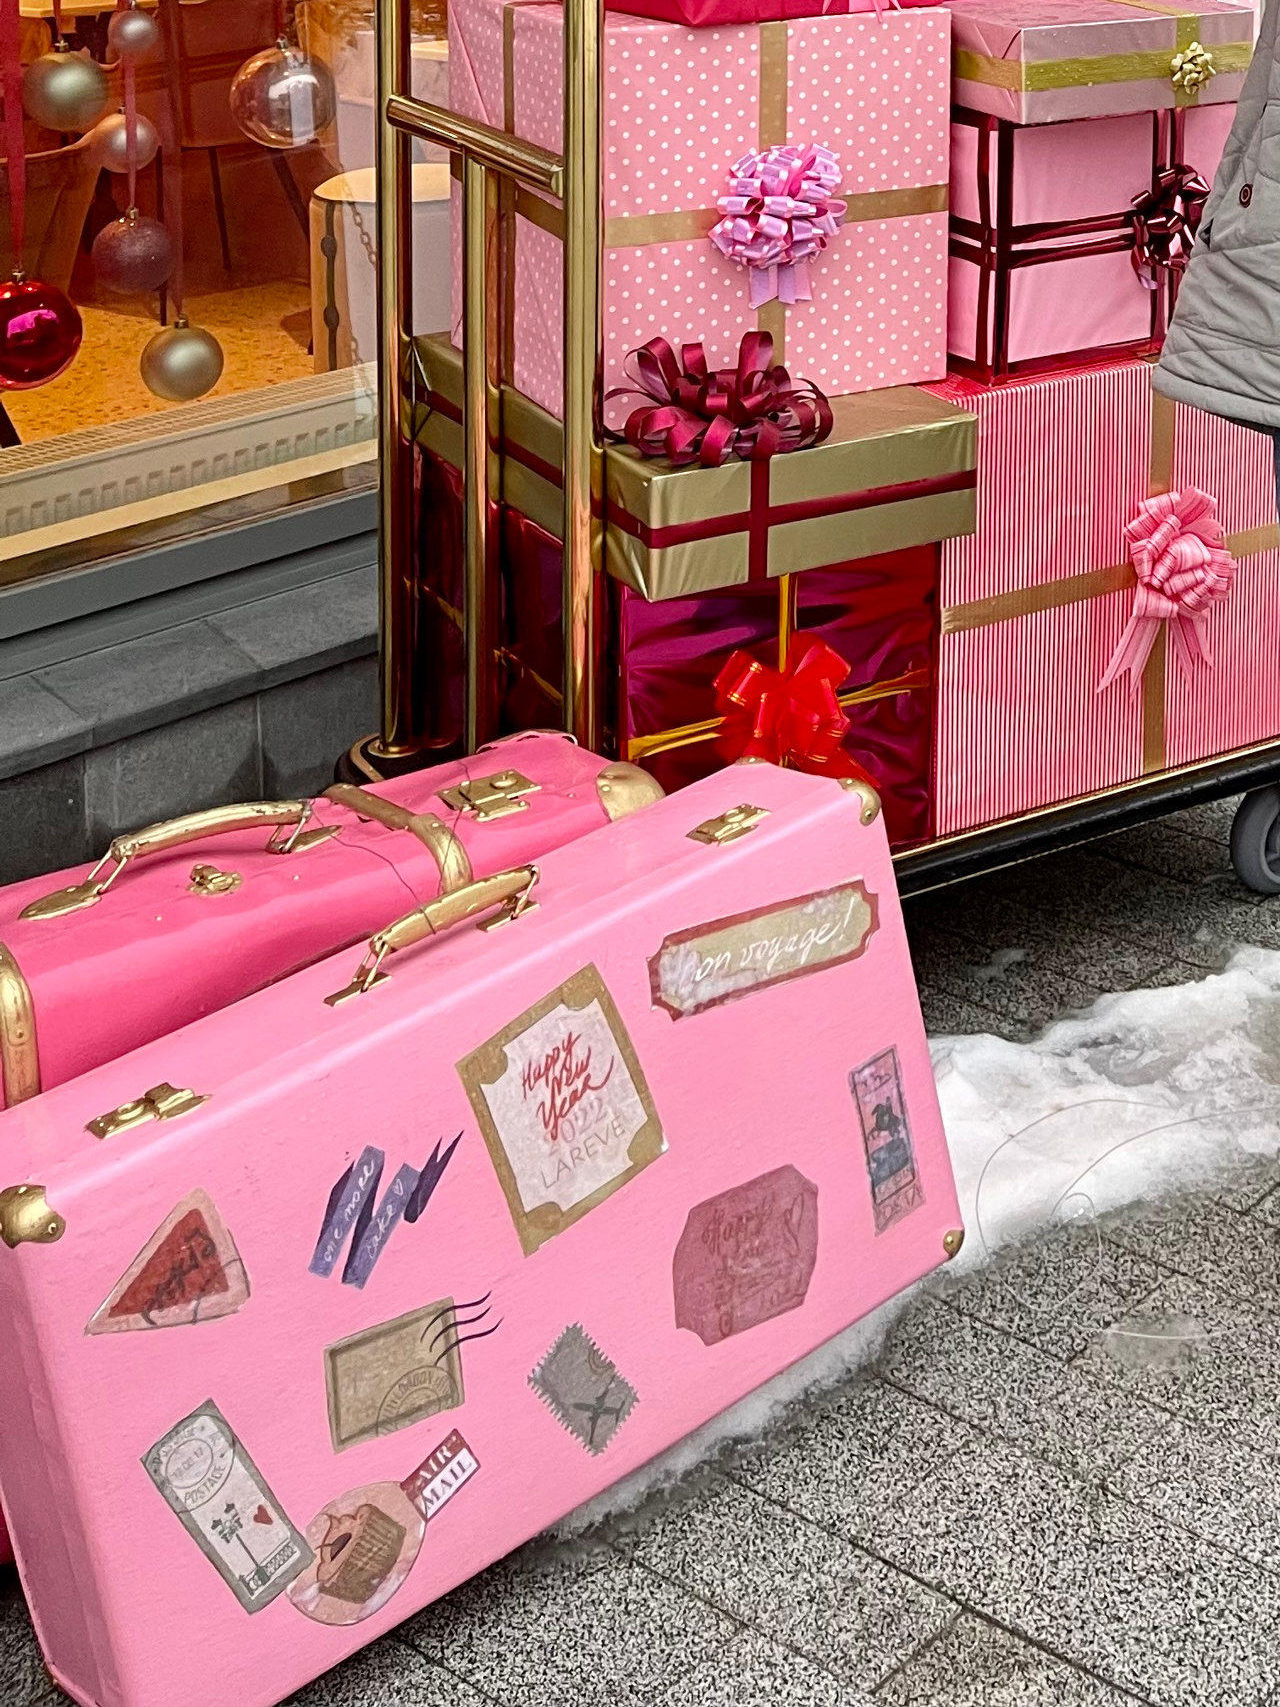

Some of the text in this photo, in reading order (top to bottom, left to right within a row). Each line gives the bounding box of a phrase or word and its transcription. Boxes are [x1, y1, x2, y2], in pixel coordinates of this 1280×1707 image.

[740, 896, 856, 973] voyage!
[522, 1031, 582, 1100] Happy
[552, 1046, 592, 1095] New
[541, 1118, 626, 1190] LAREVE
[184, 1465, 226, 1504] POSTAGE
[415, 1445, 452, 1488] AIR
[424, 1460, 472, 1511] MAIL
